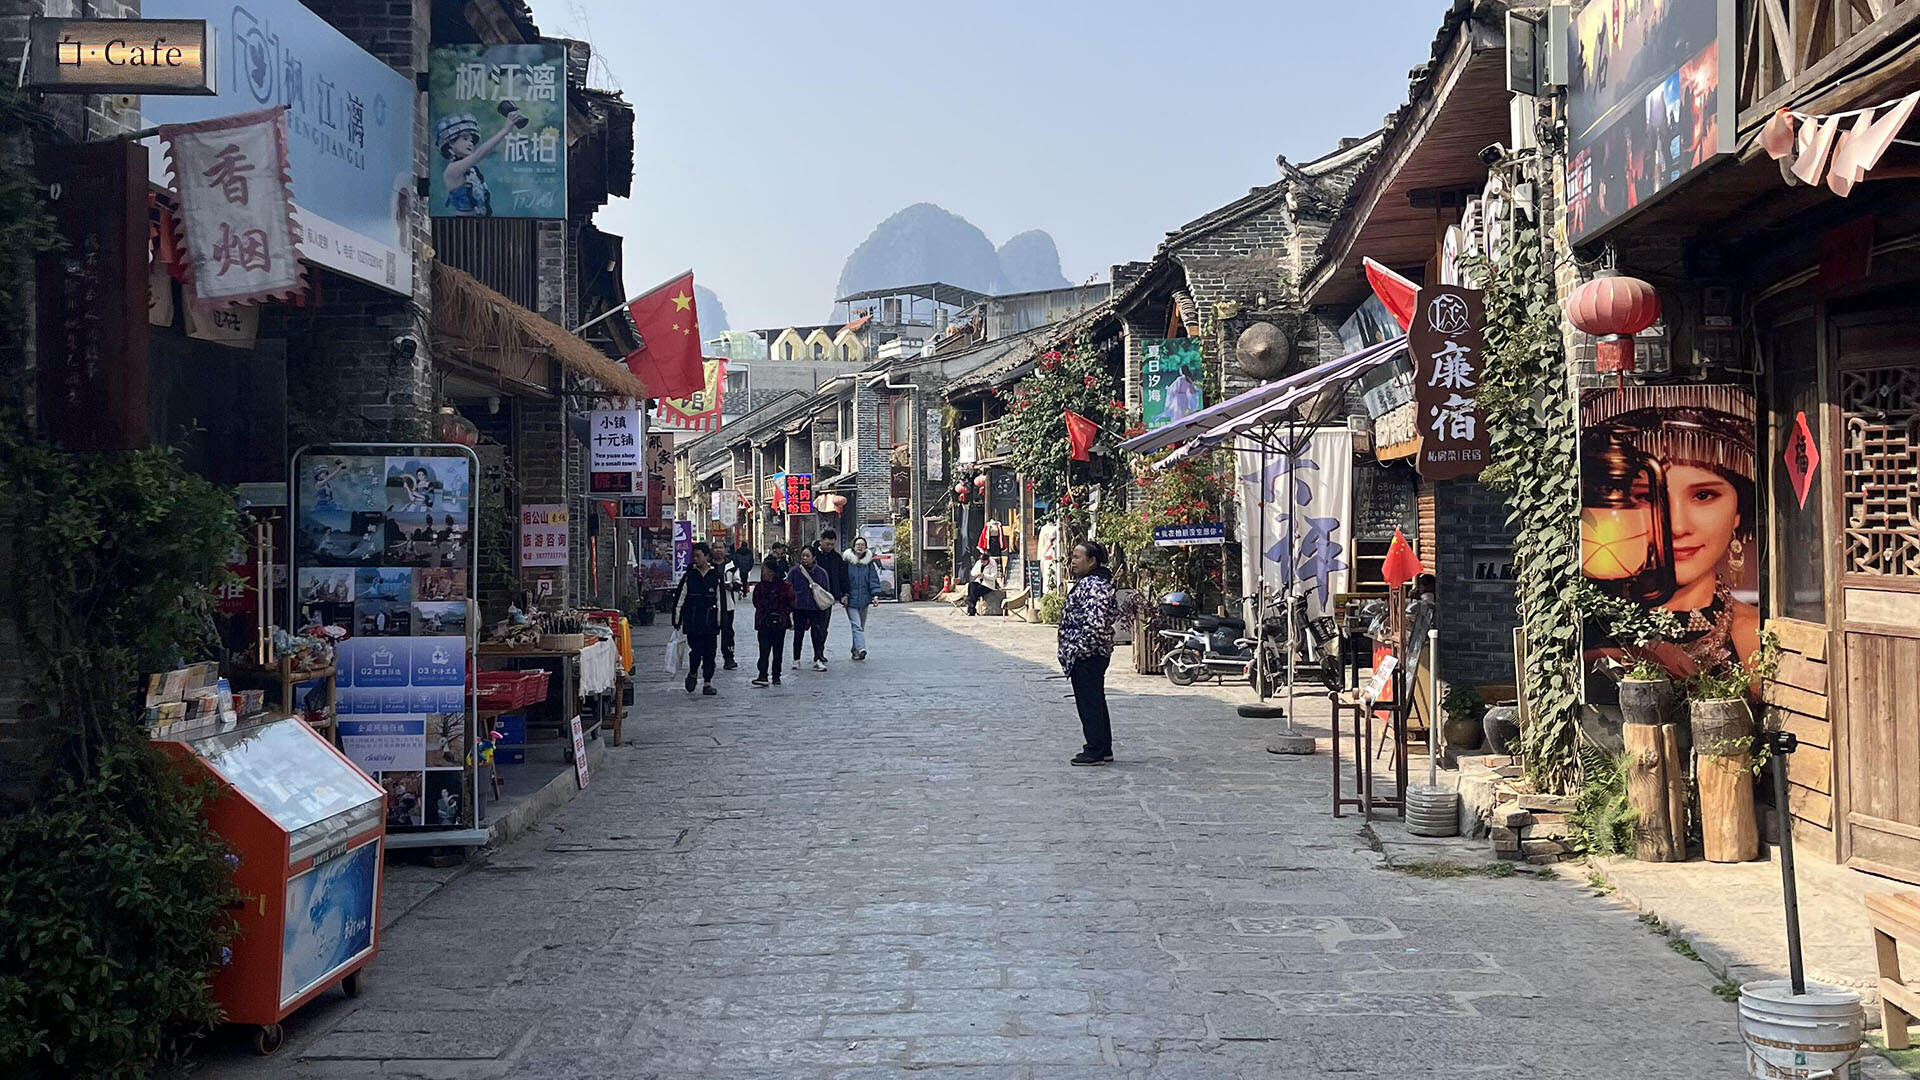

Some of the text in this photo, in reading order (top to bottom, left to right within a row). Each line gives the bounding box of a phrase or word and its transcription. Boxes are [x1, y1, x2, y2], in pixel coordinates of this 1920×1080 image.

[105, 37, 182, 67] Cafe
[456, 63, 556, 101] 枫江漓
[504, 132, 557, 163] 旅拍
[203, 144, 271, 277] 香烟
[1148, 345, 1161, 402] 夏日汐海
[1428, 340, 1476, 442] 廉宿
[600, 415, 627, 430] 小镇
[594, 433, 634, 448] 十元铺
